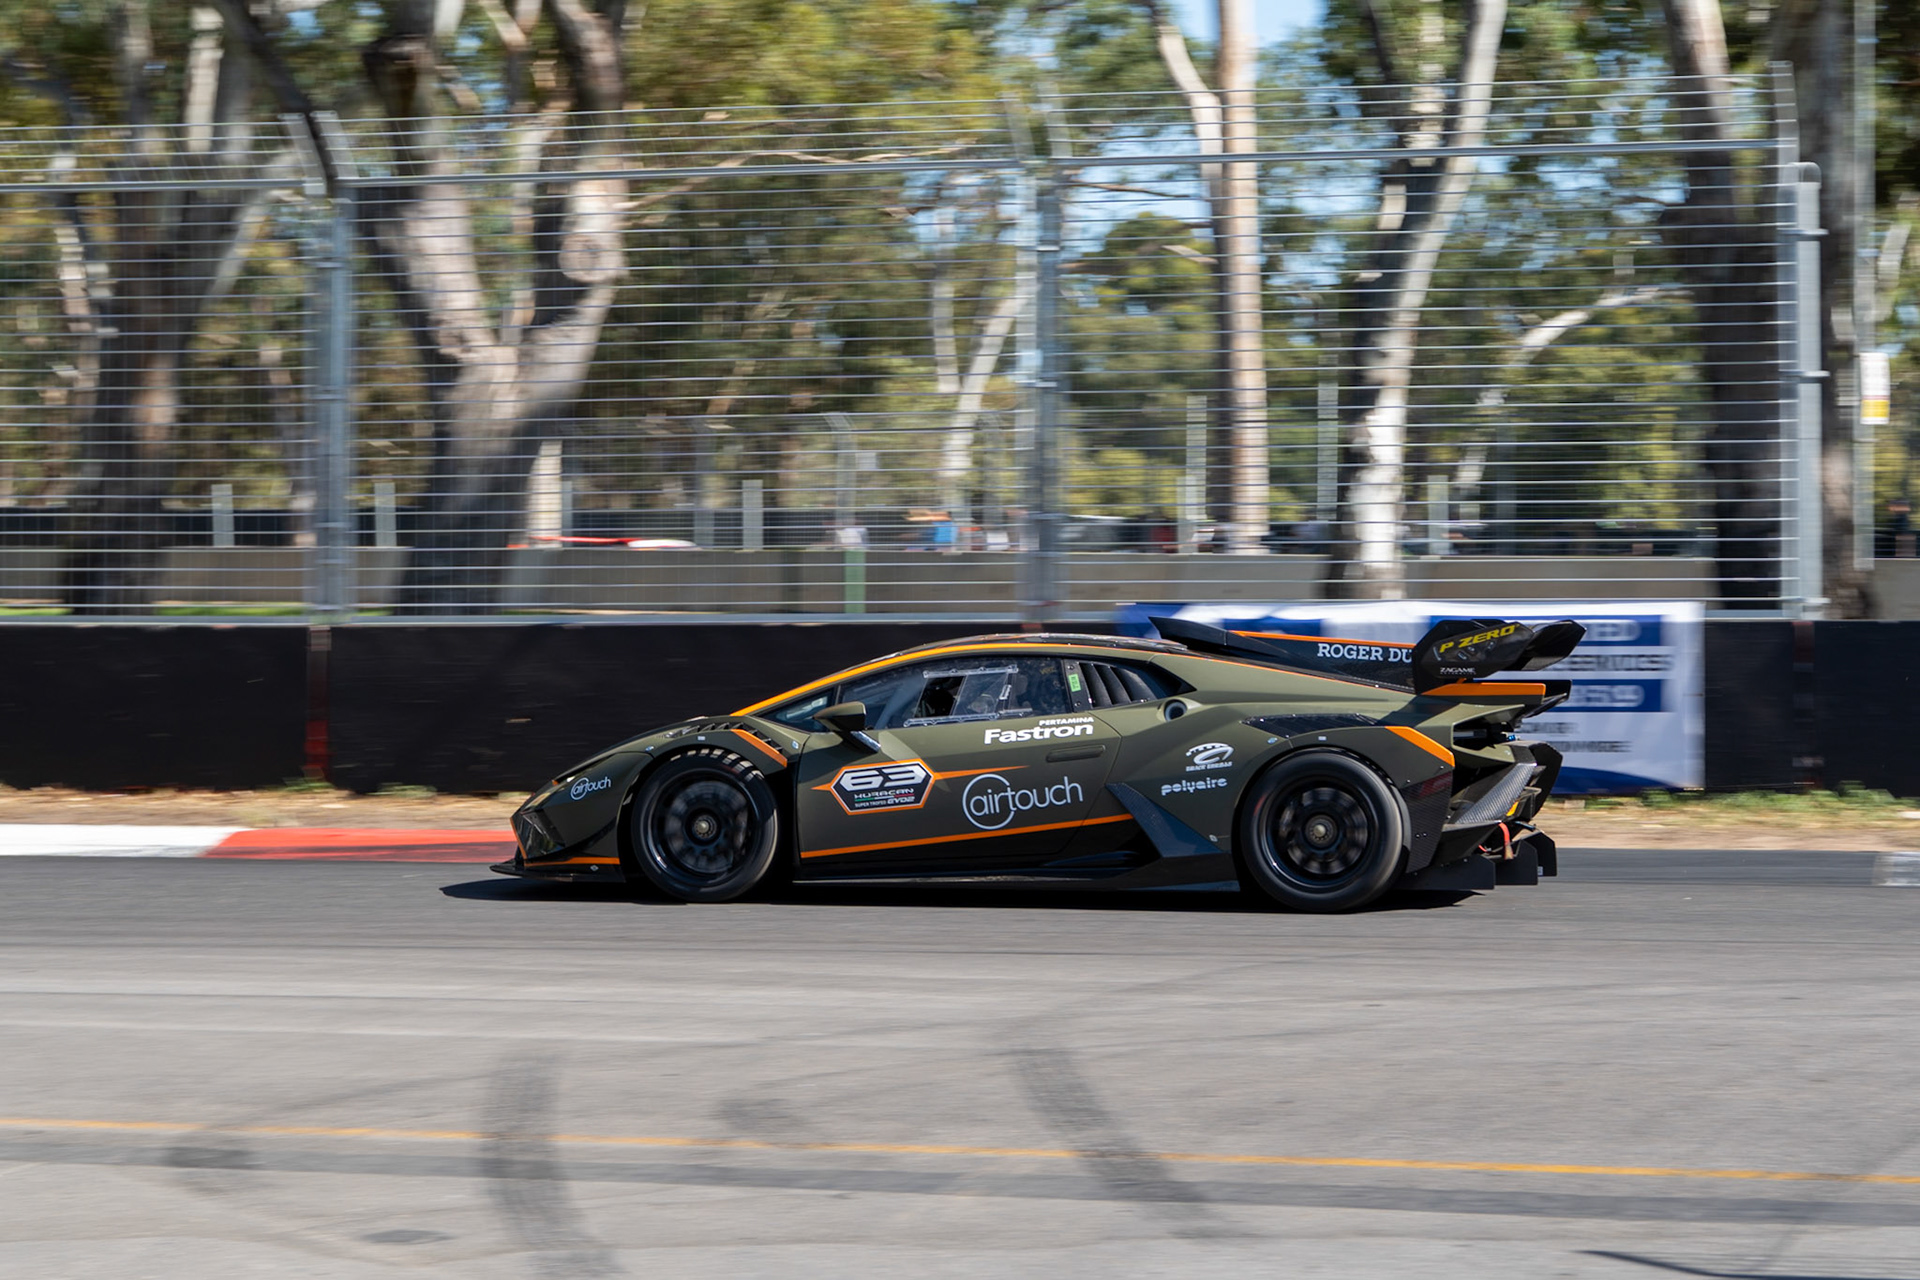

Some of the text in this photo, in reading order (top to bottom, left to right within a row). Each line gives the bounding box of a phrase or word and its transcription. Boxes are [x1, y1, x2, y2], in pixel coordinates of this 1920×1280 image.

[1439, 625, 1516, 654] P ZERO
[1317, 643, 1384, 661] ROGER
[1039, 716, 1095, 726] PERTAMINA
[984, 724, 1094, 745] Fastron
[572, 776, 612, 798] airtouch
[840, 764, 927, 791] 63
[1161, 777, 1228, 796] polyaire
[854, 788, 915, 799] HURACAN
[967, 775, 1084, 821] airtouch
